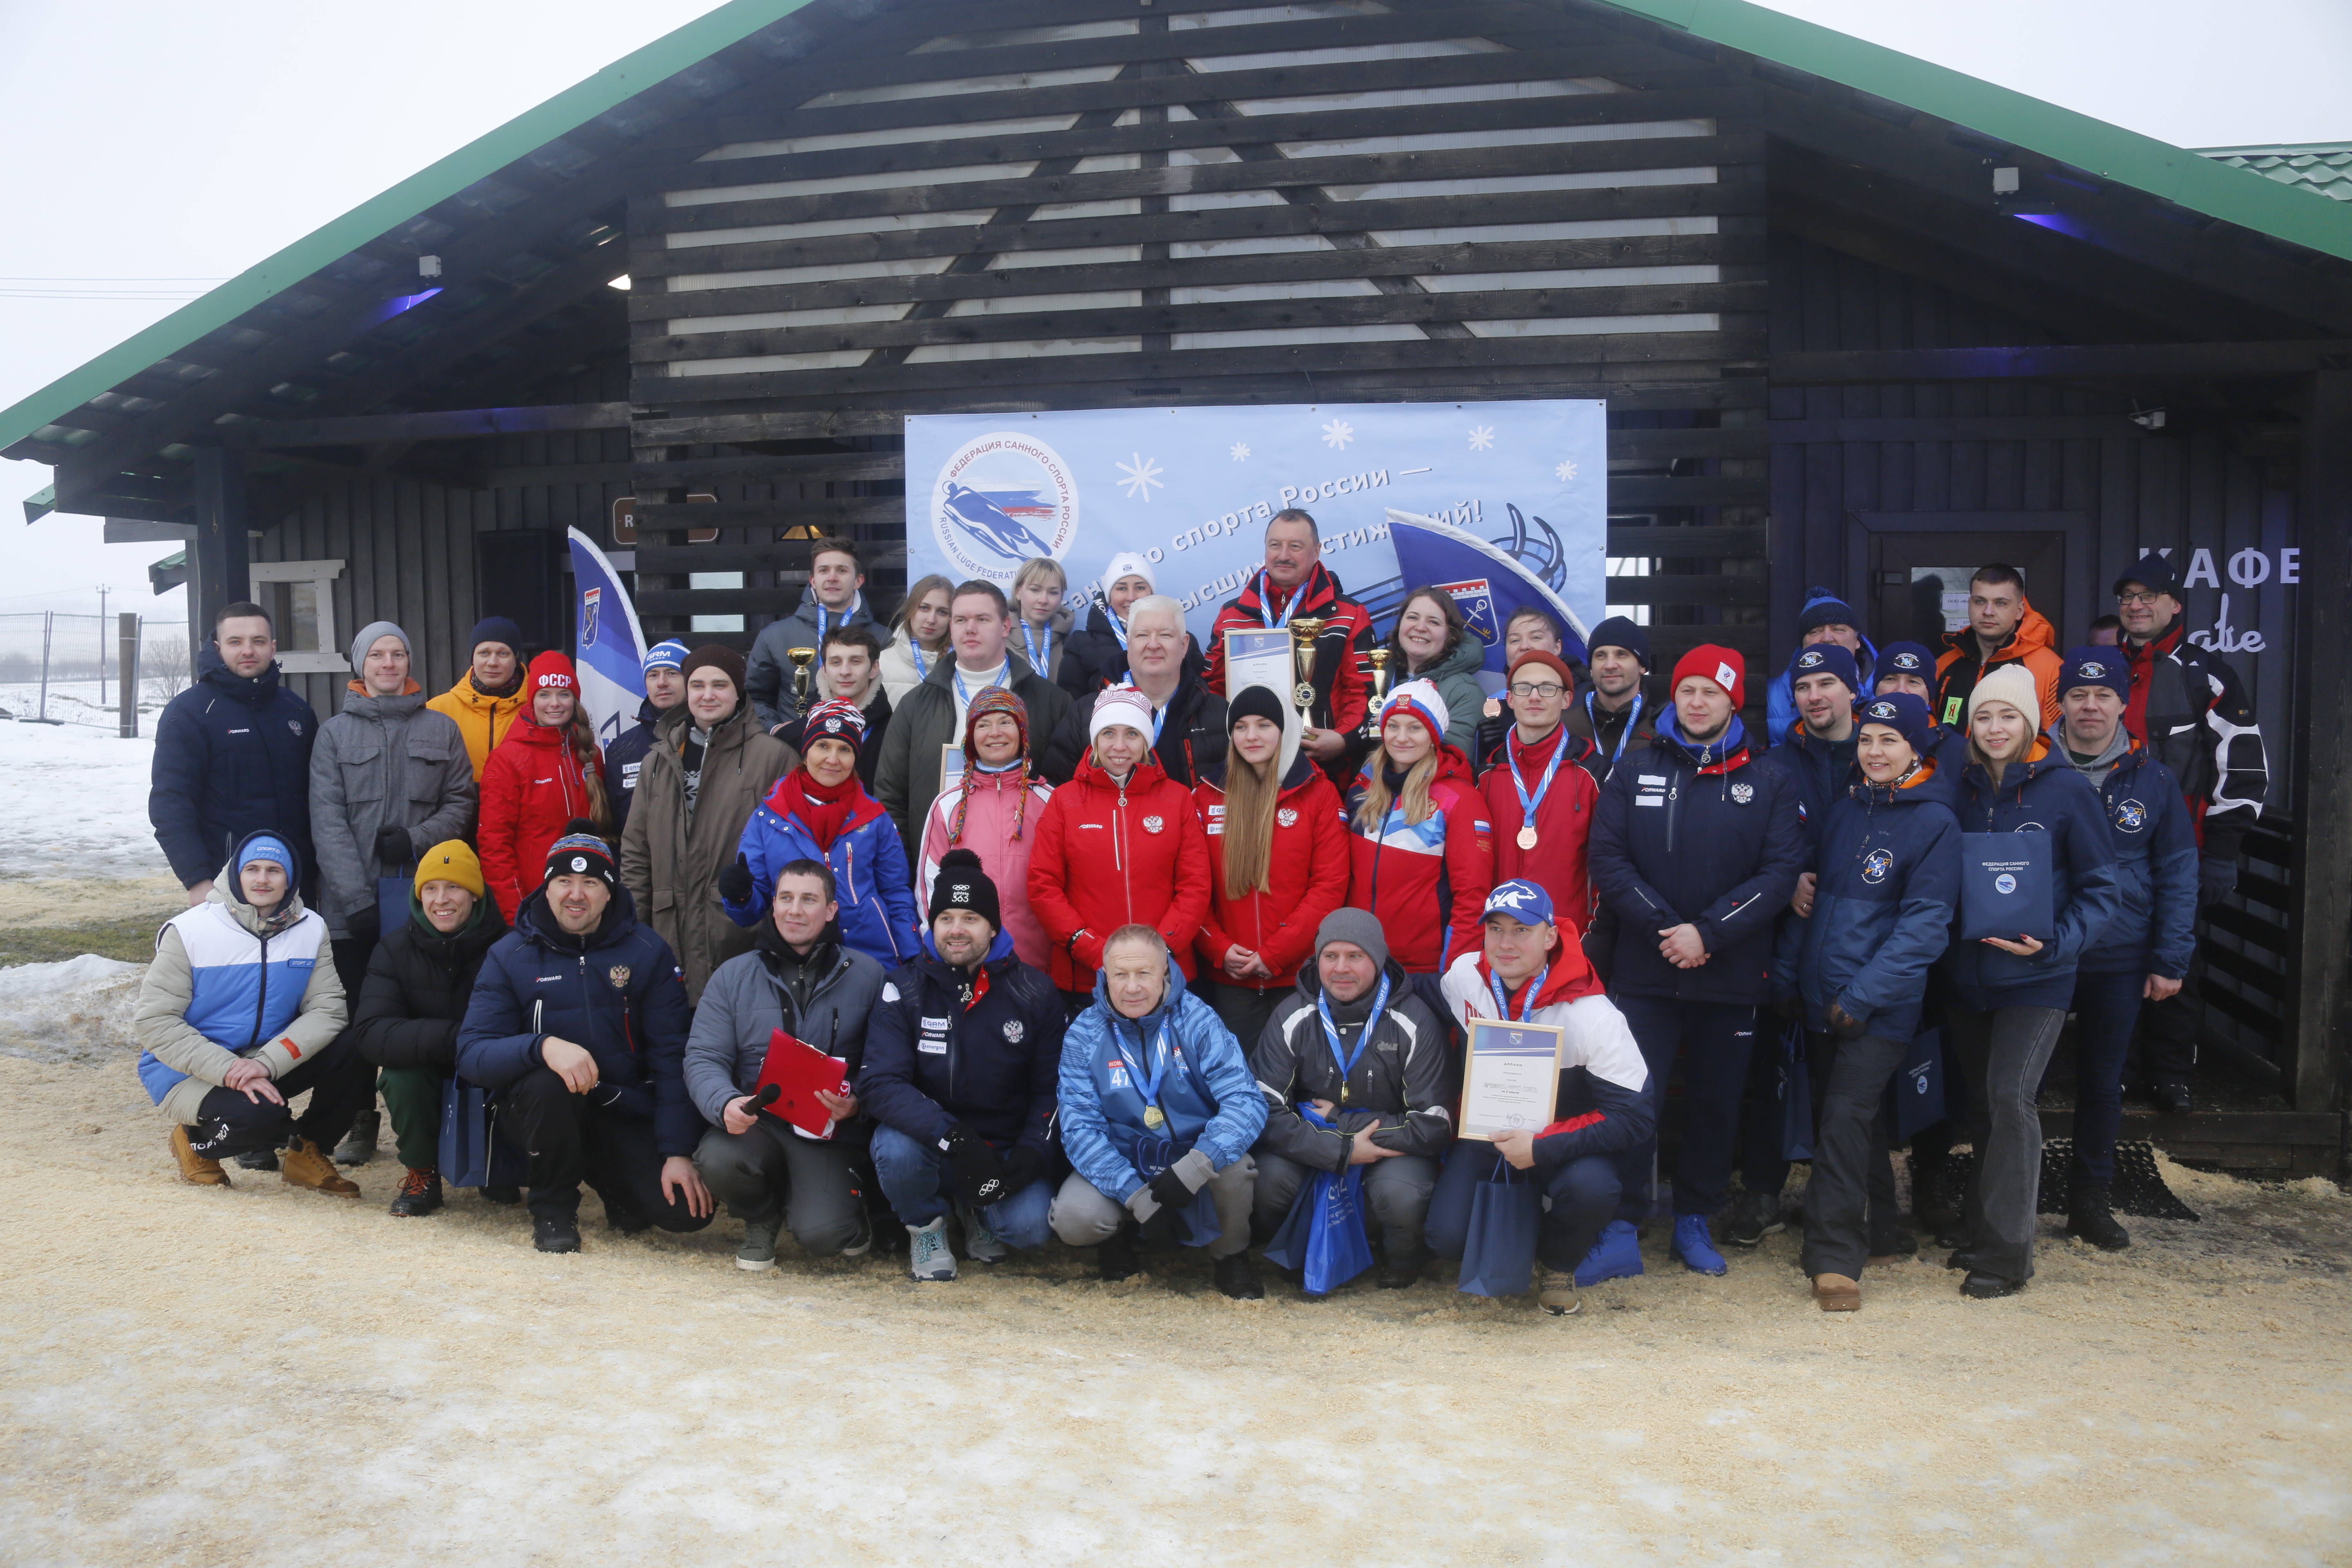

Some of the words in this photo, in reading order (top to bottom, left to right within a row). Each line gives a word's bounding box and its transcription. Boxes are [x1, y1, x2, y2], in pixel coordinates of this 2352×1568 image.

[950, 441, 1001, 478] ФЕДЕРАЦИЯ
[1004, 441, 1049, 464] САННОГО
[1048, 463, 1069, 503] СПОРТА
[1172, 500, 1273, 551] спорта
[1279, 469, 1390, 510] России
[1052, 506, 1070, 549] РОССИИ
[940, 517, 960, 554] RUSSIAN
[956, 552, 976, 571] LUGE
[976, 566, 1017, 579] FEDERATI
[1296, 584, 1306, 599] СПОРТ
[2187, 593, 2266, 653] ake
[646, 651, 670, 661] GRM
[539, 673, 571, 687] ФССР
[996, 671, 1005, 686] СПОРТ
[1629, 707, 1638, 725] СПОРТ
[1555, 741, 1565, 759] СПОРТ
[1376, 989, 1386, 1010] СПОРТ
[1496, 987, 1505, 1009] СПОРТ
[1525, 989, 1535, 1011] СПОРТ
[1112, 1069, 1128, 1086] 47
